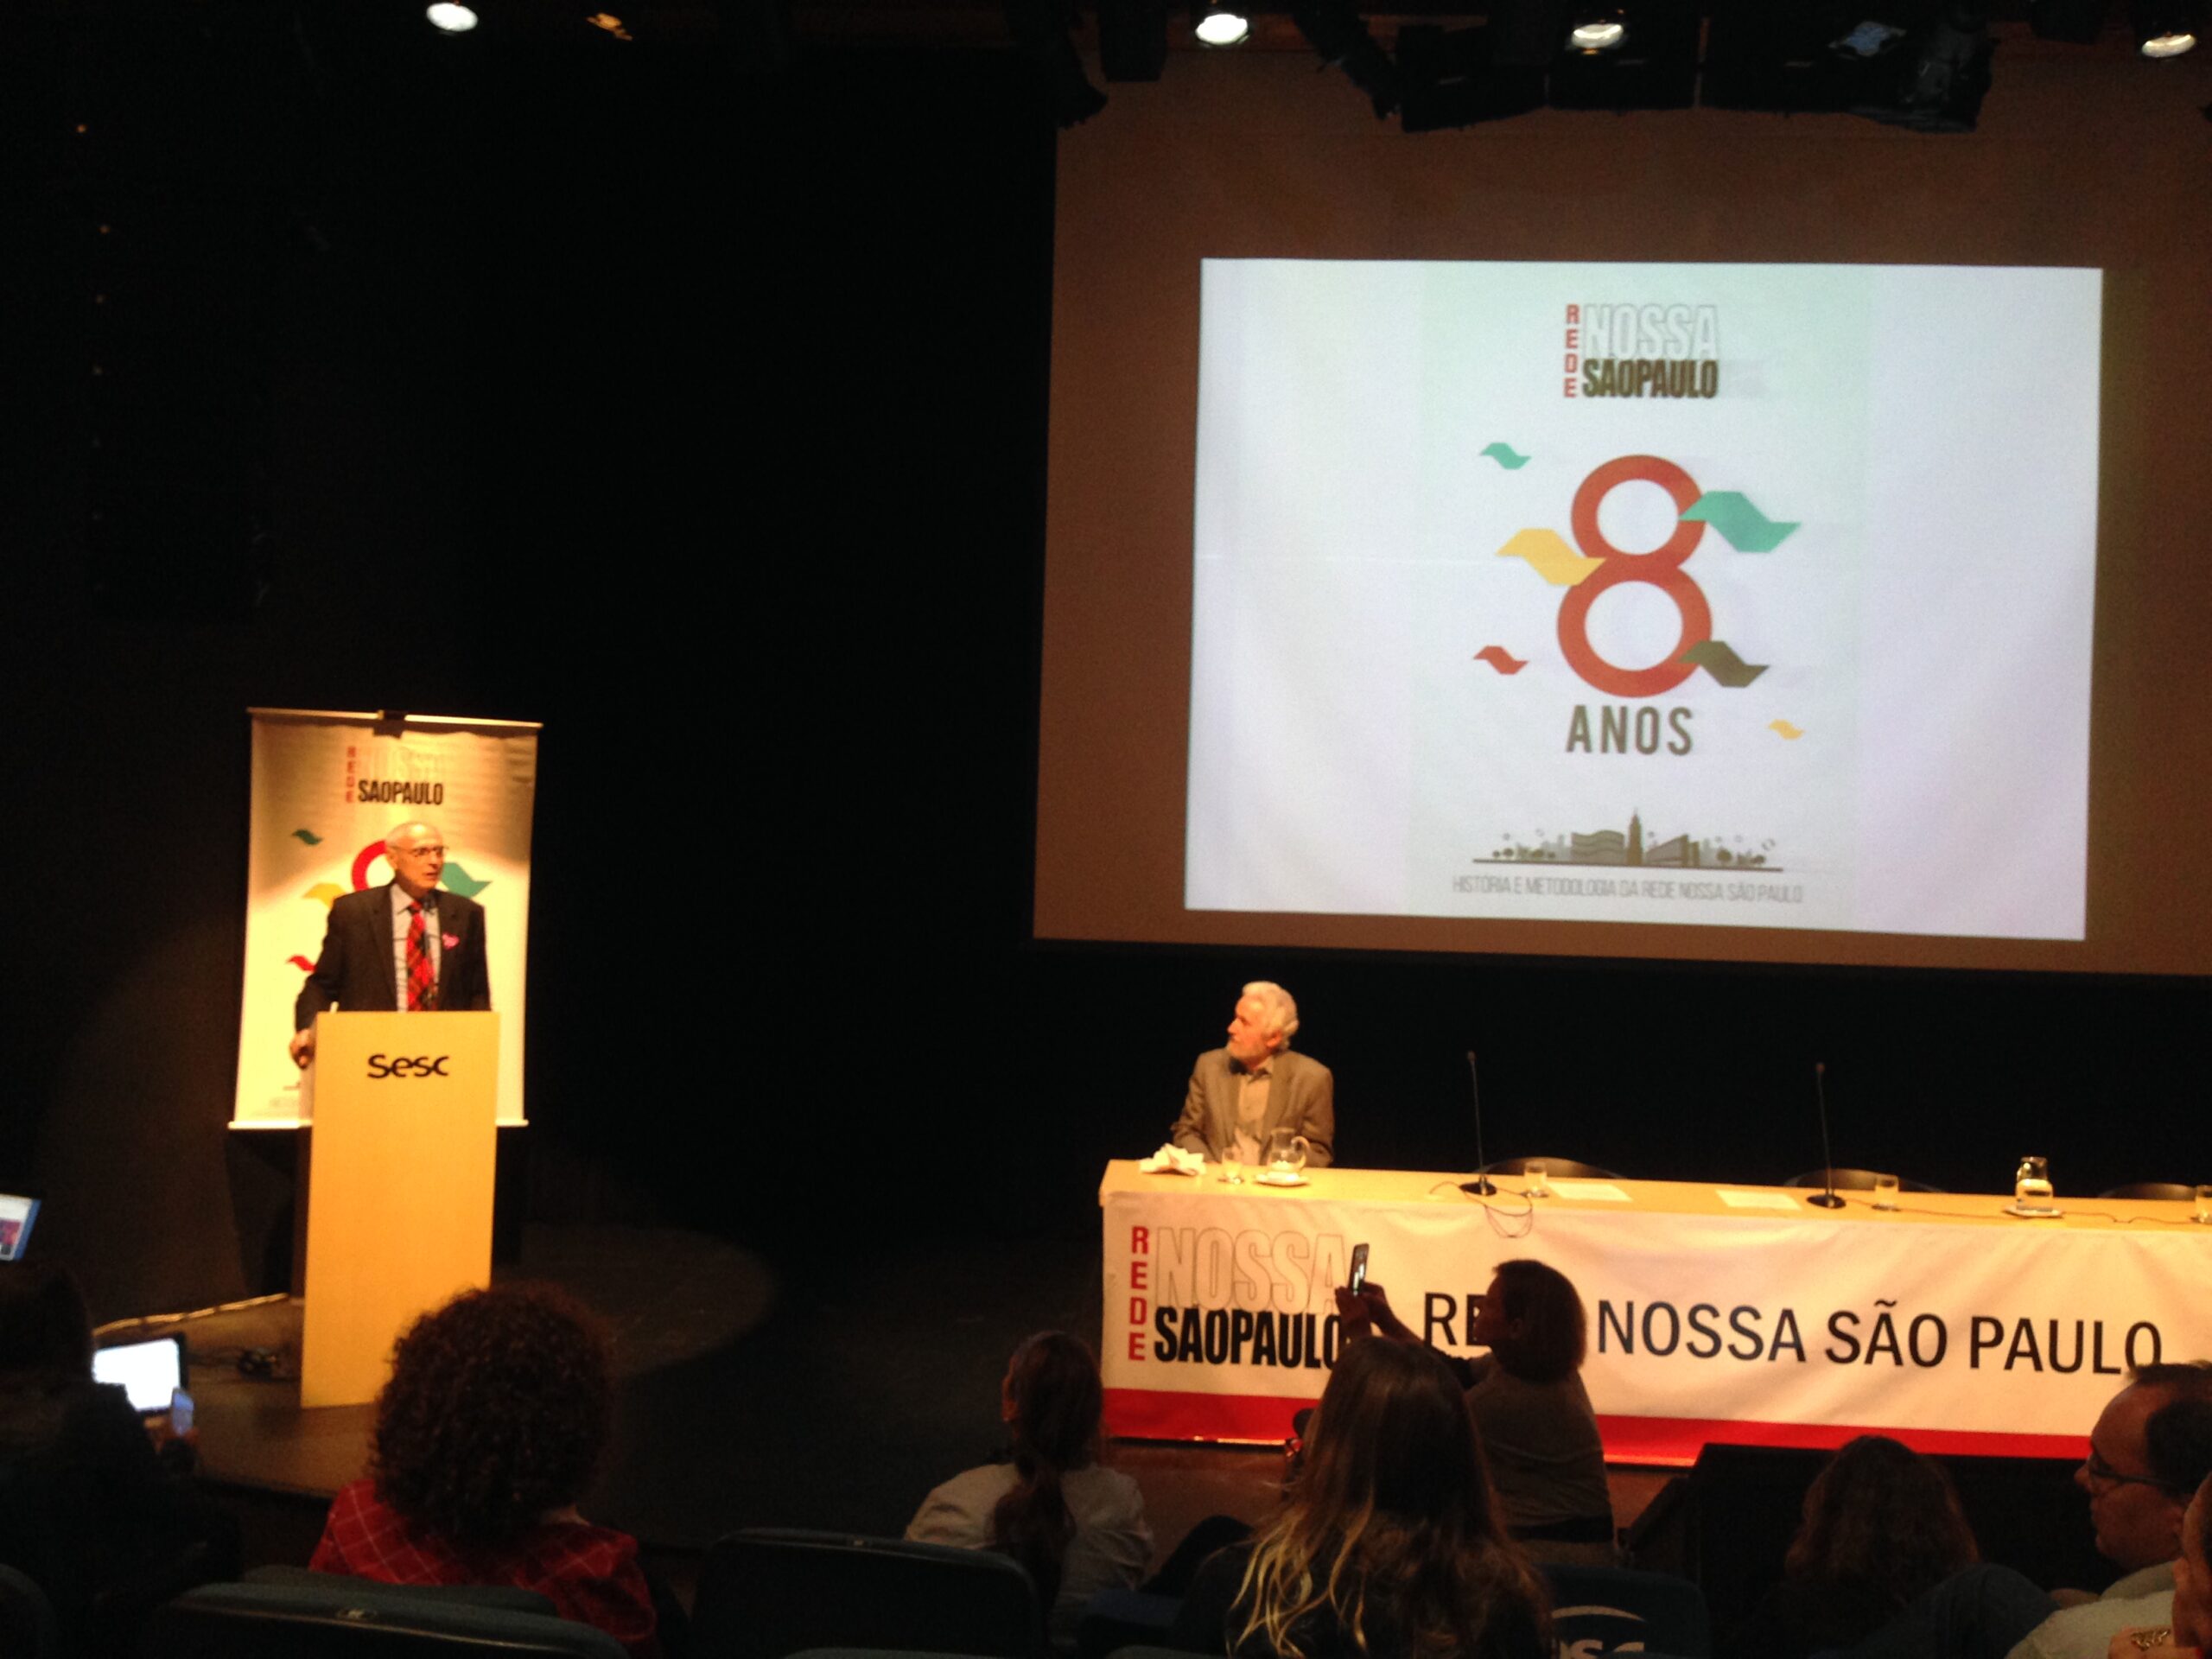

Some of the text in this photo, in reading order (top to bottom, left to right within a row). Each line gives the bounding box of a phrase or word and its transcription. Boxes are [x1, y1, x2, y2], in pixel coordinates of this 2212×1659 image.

[1564, 304, 1580, 397] REDE
[1582, 303, 1719, 359] NOSSA
[1556, 454, 1713, 698] 8
[1566, 704, 1694, 756] ANOS
[1514, 876, 1522, 895] E
[1526, 876, 1616, 897] METODOLOGIA
[1619, 880, 1638, 899] DA
[1642, 881, 1675, 899] REDE
[1679, 882, 1723, 901] NOSSA
[1758, 885, 1803, 904] PAULO
[1128, 1225, 1148, 1362] REDE
[1155, 1226, 1348, 1315] NOSSA
[1424, 1292, 2162, 1375] RE NOSSA SÃO PAULO
